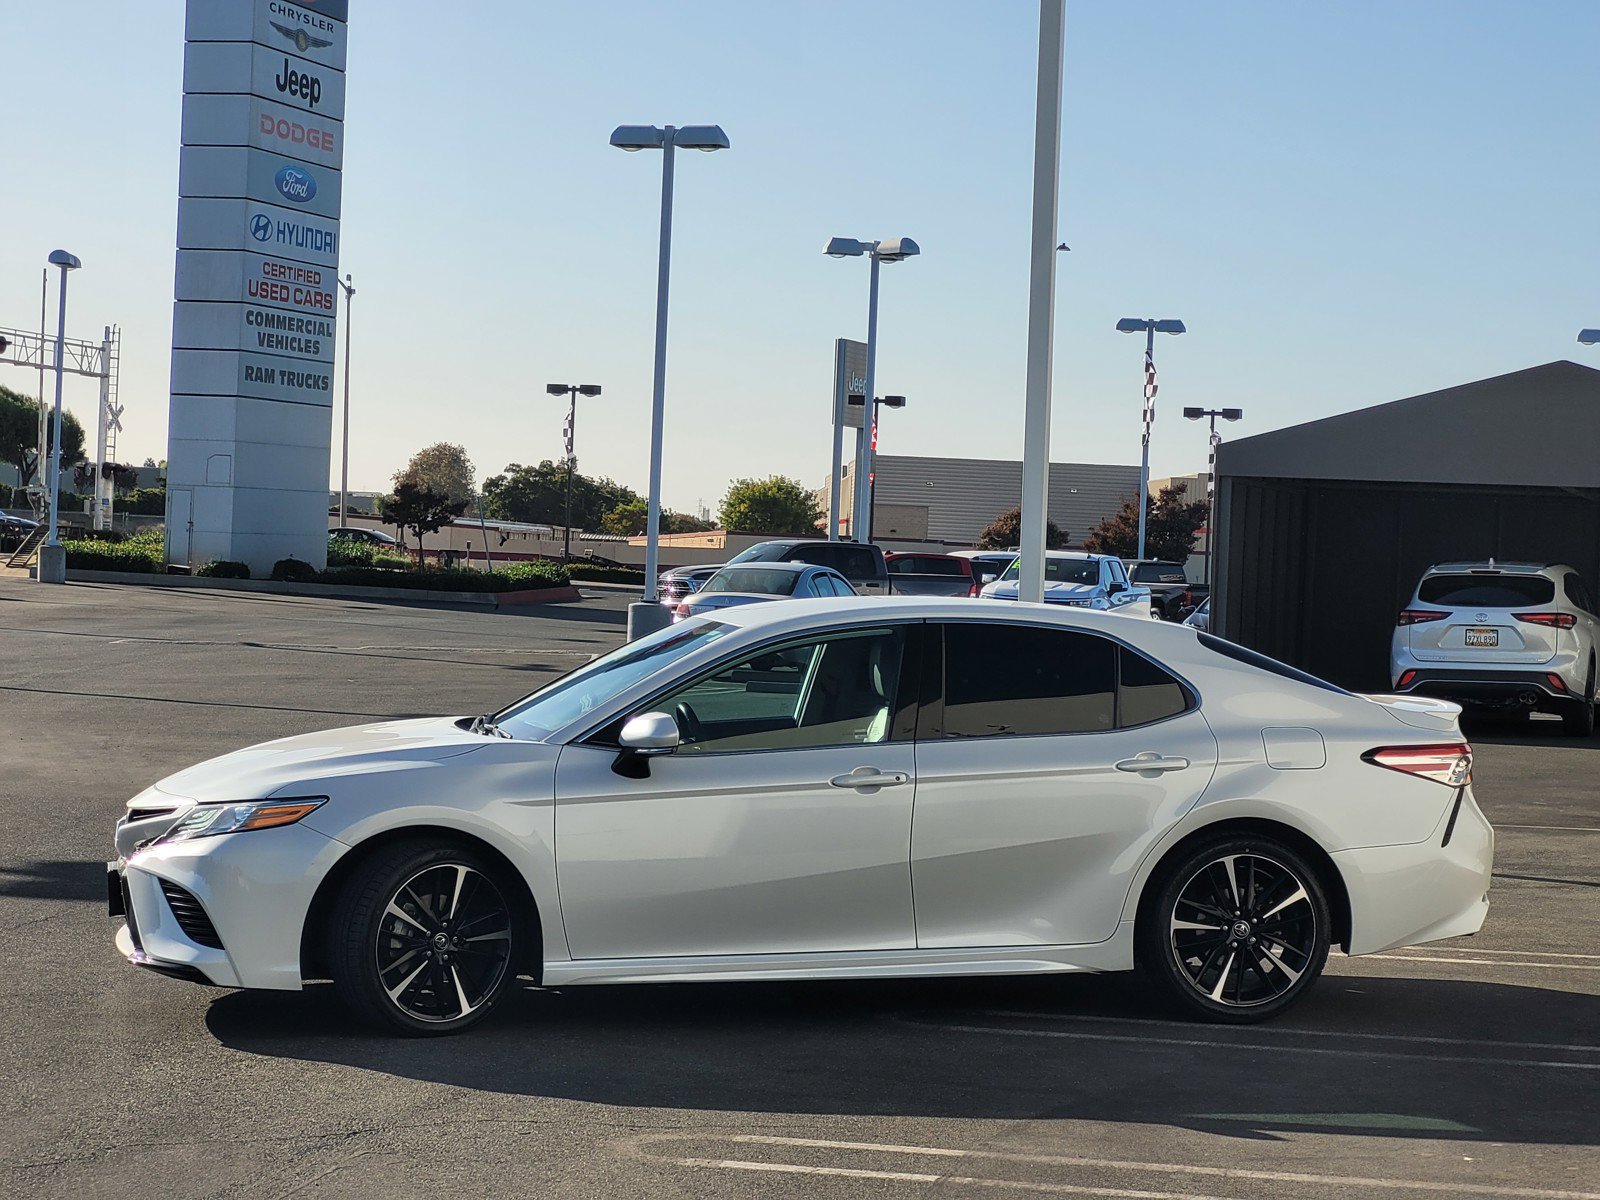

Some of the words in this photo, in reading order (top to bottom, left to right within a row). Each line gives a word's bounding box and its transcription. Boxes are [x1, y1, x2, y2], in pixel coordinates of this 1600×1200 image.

[269, 2, 334, 33] CHRYSLER
[275, 58, 321, 107] Jeep
[260, 113, 334, 152] DODGE
[282, 169, 309, 197] Ford
[276, 220, 336, 254] HYUNDAI
[262, 261, 321, 285] CERTIFIED
[248, 279, 290, 304] USED
[293, 287, 333, 310] CARS
[245, 310, 332, 338] COMMERCIAL
[257, 331, 320, 355] VEHICLES
[244, 365, 275, 385] RAM
[279, 370, 329, 391] TRUCKS
